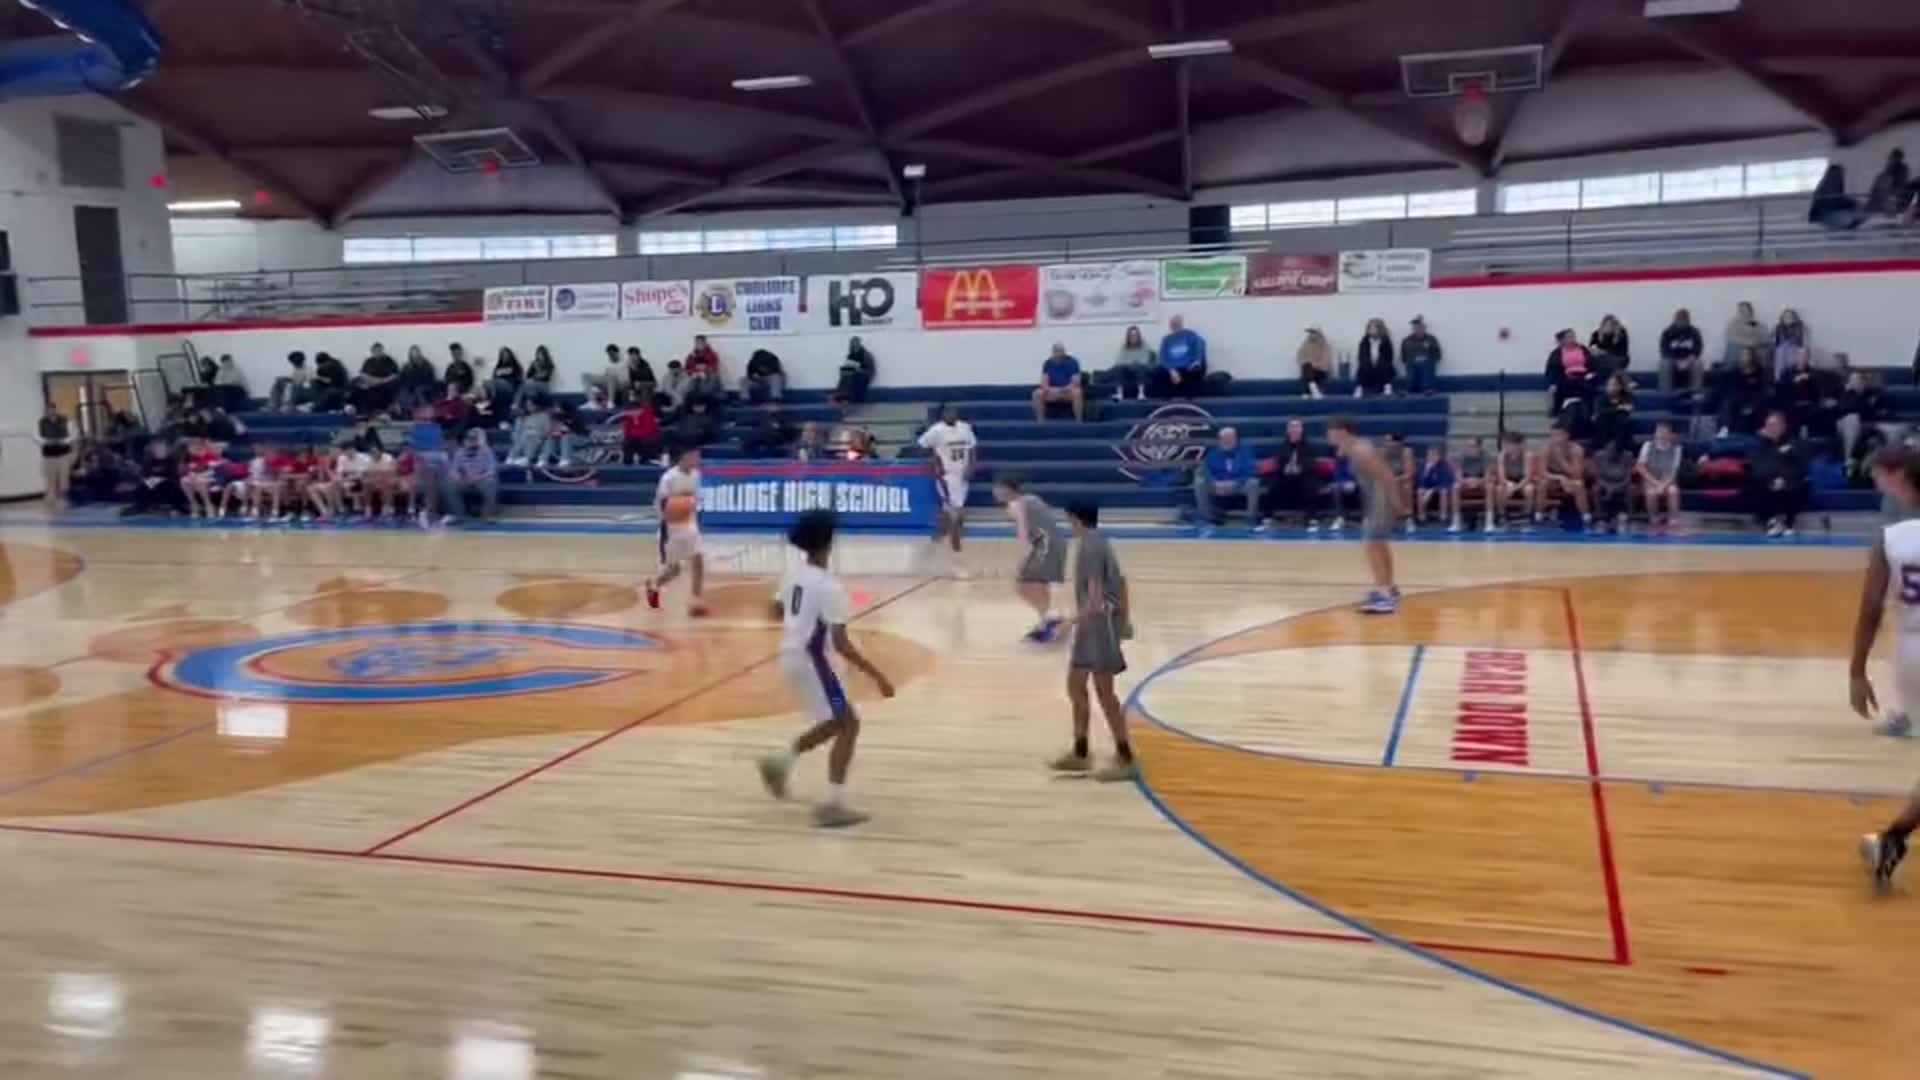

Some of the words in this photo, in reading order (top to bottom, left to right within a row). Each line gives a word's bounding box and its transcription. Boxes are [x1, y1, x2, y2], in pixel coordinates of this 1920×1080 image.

[748, 315, 781, 331] CLUB
[782, 480, 832, 512] HIGH
[835, 482, 912, 513] SCHOOL
[790, 584, 804, 616] 0
[1459, 651, 1527, 694] BEAR
[1451, 702, 1529, 766] DOWN
